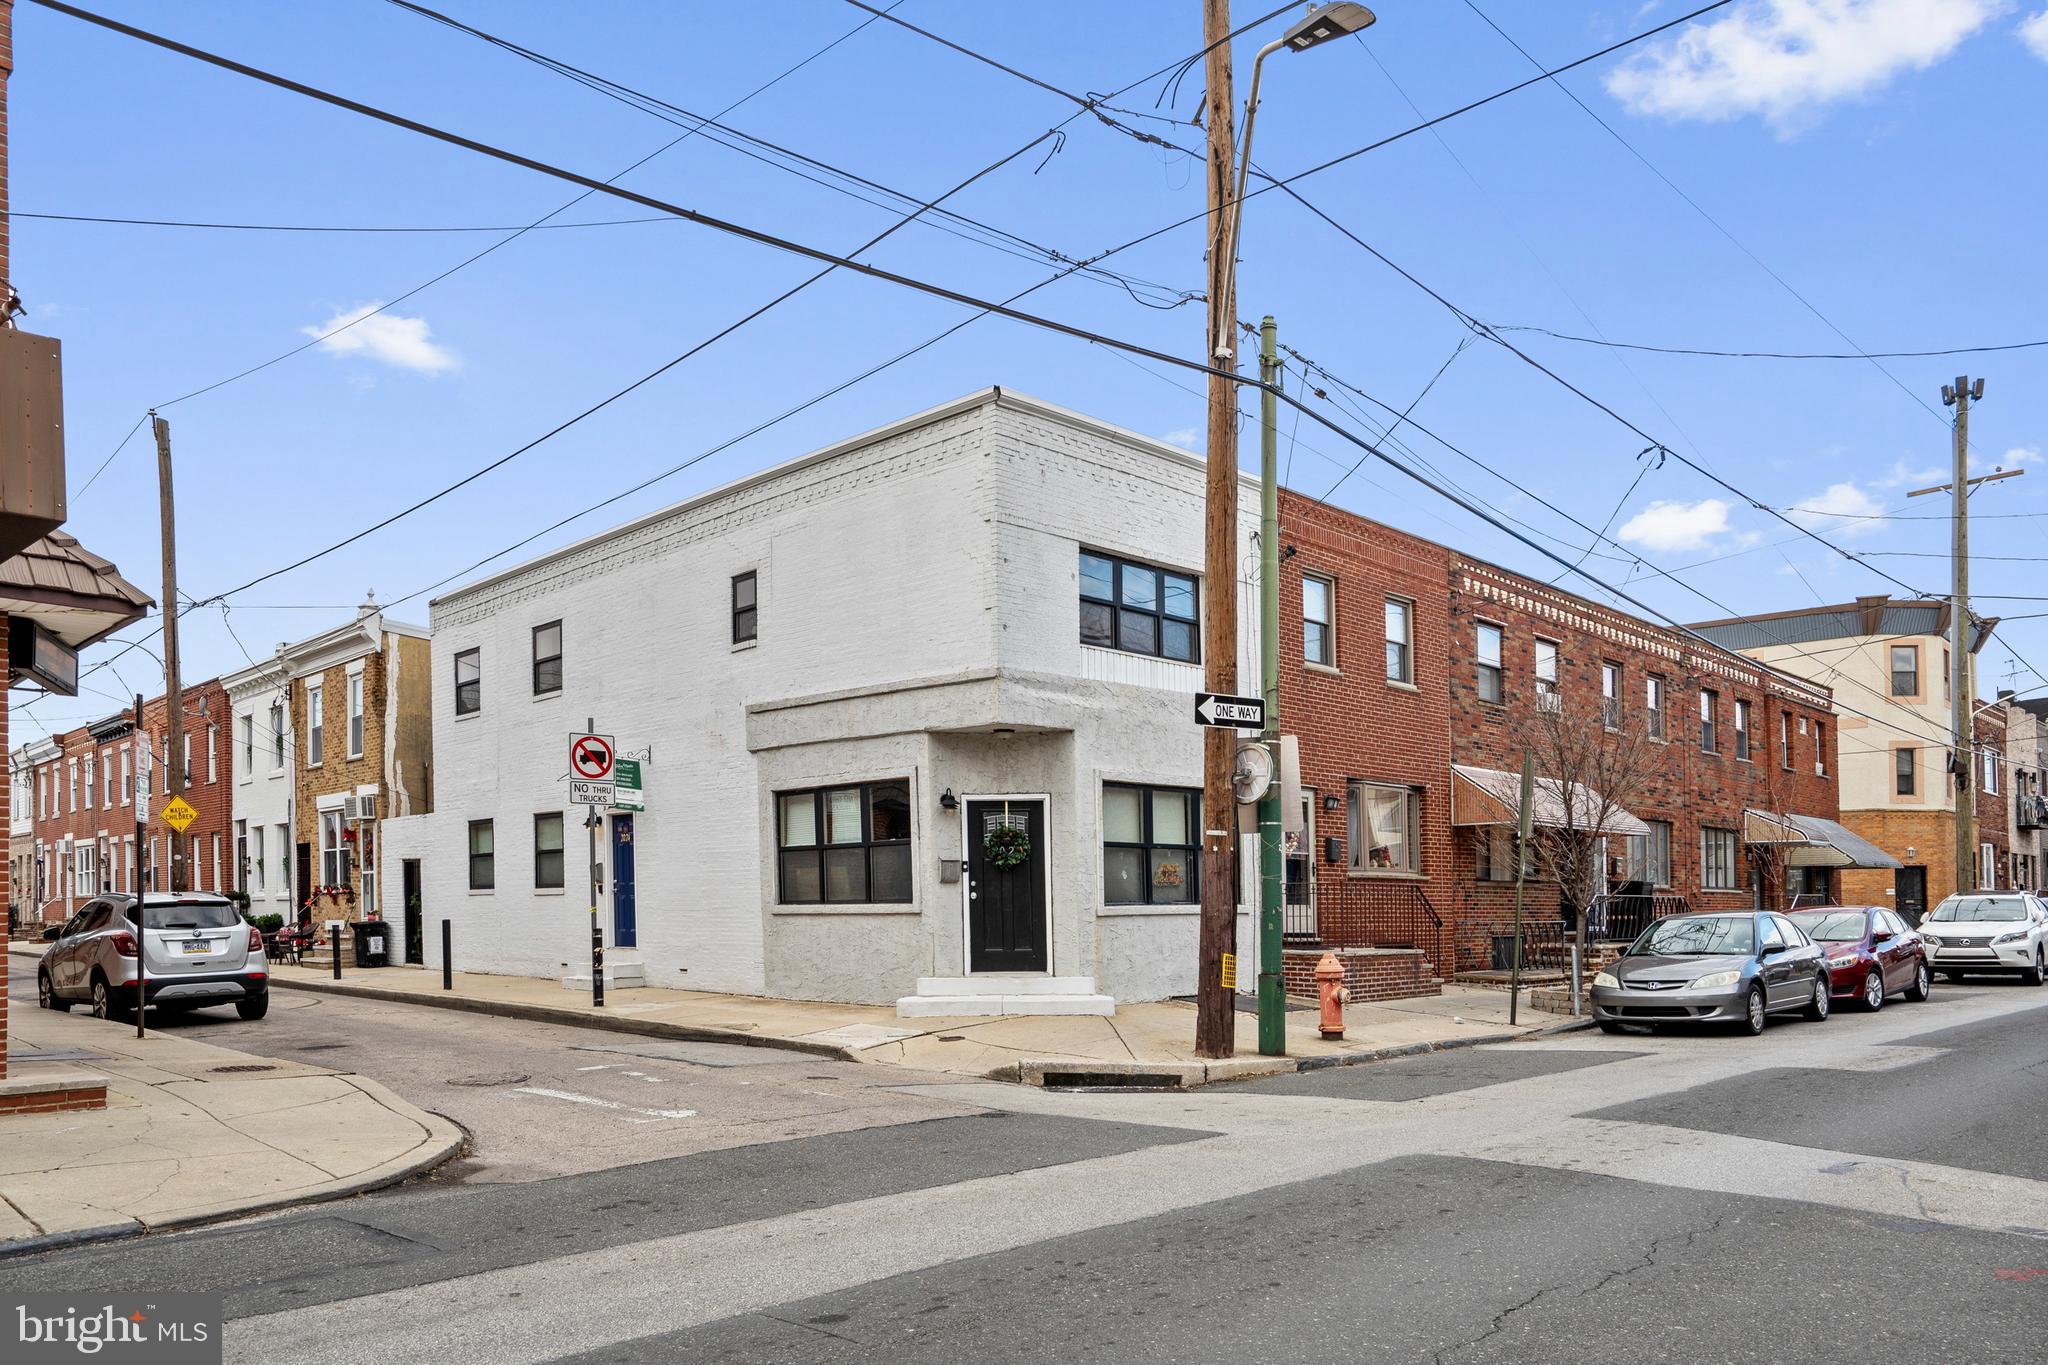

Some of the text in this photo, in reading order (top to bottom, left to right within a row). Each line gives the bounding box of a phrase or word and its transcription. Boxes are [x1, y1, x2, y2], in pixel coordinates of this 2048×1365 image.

[1215, 704, 1258, 720] ONE WAY
[574, 783, 589, 793] NO
[593, 786, 612, 795] THRU
[579, 794, 607, 803] TRUCKS
